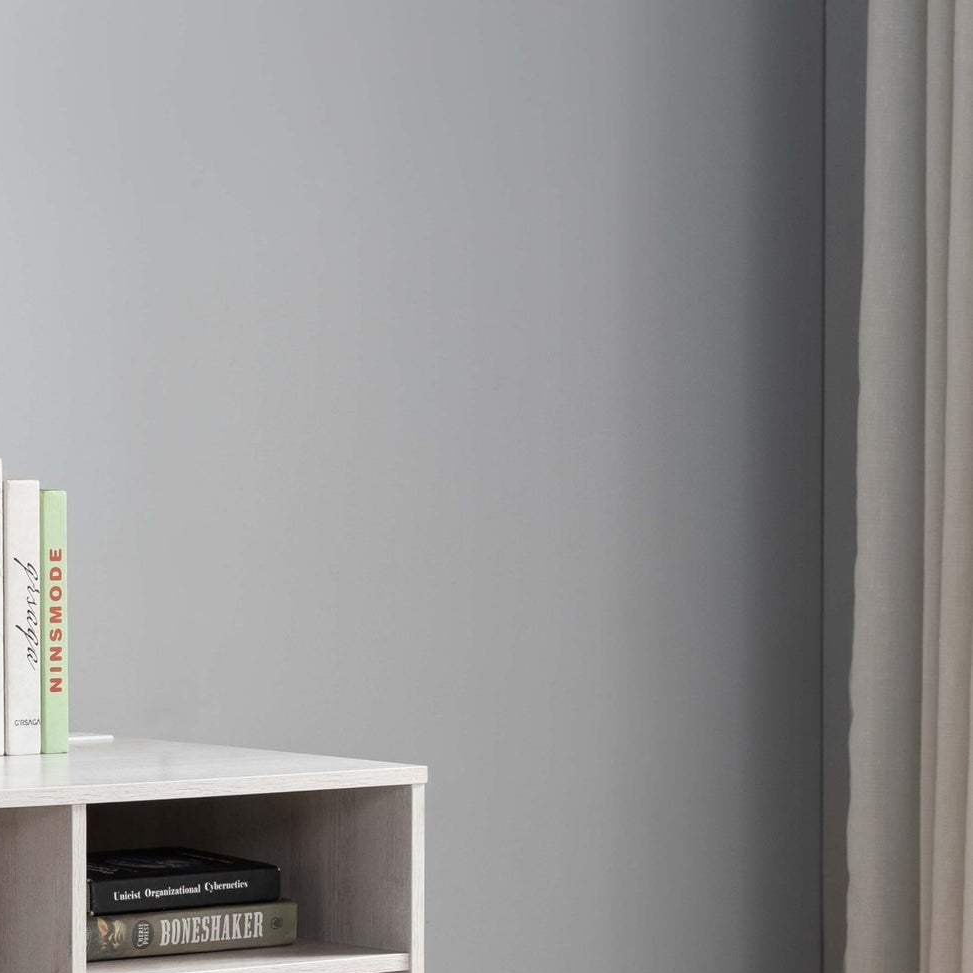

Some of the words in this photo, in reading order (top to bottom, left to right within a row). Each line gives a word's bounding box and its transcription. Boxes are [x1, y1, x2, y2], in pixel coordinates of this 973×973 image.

[49, 548, 62, 693] NINSMODE
[113, 890, 141, 901] Unicist
[144, 884, 201, 898] Organizational
[204, 879, 248, 893] Cybernetics
[159, 911, 264, 946] BONESHAKER
